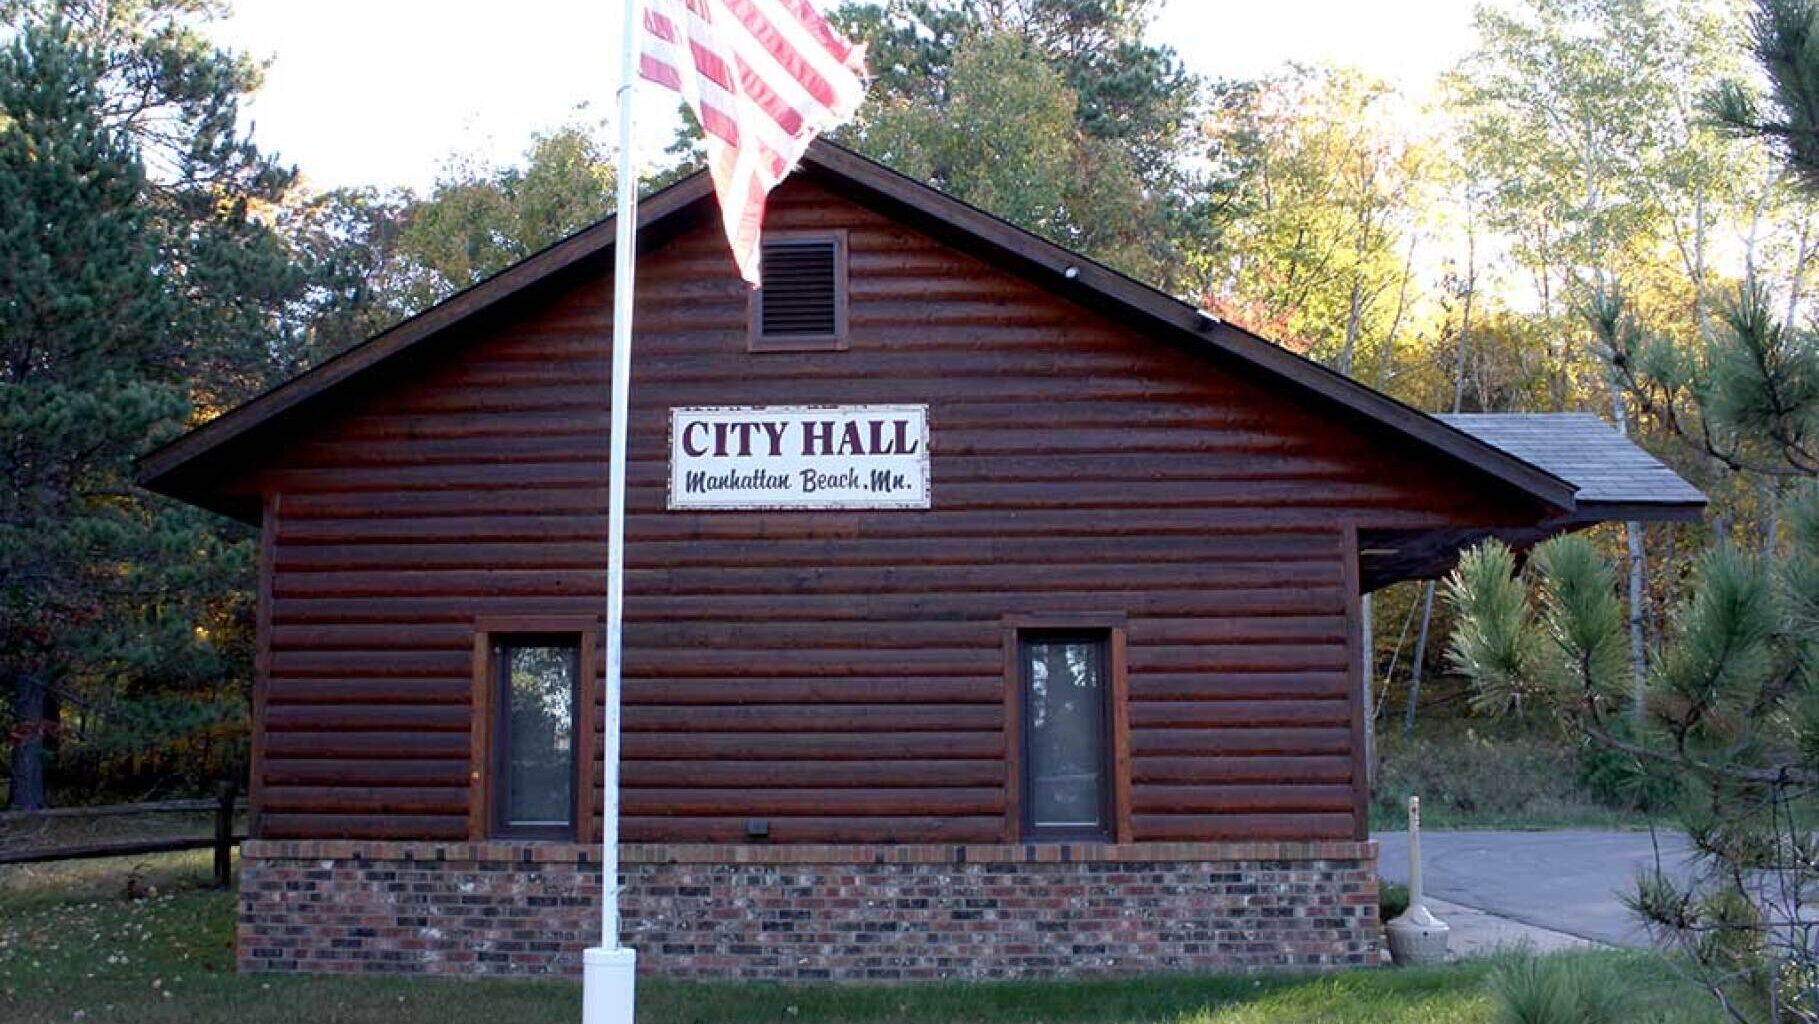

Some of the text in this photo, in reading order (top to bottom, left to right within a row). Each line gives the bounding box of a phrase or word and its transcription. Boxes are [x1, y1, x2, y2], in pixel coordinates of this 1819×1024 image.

[682, 420, 918, 457] CITY HALL
[685, 469, 792, 493] Manhattan
